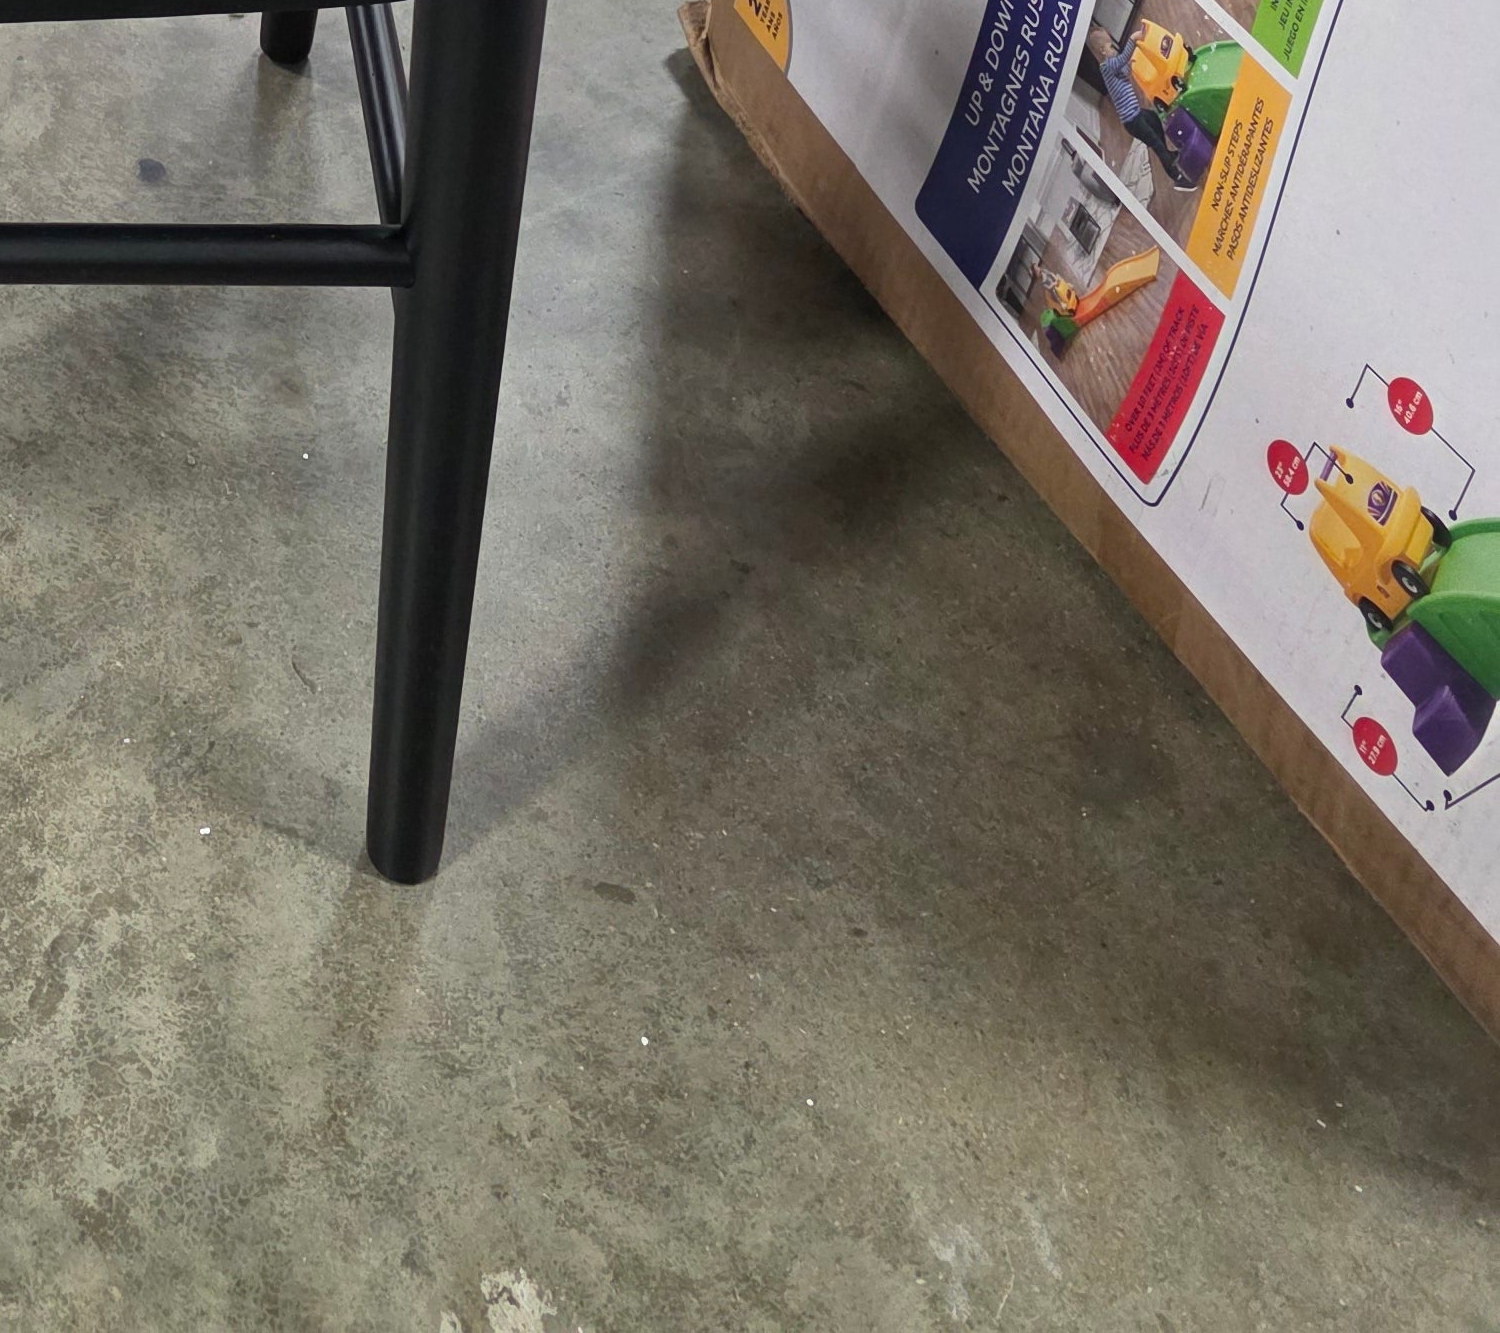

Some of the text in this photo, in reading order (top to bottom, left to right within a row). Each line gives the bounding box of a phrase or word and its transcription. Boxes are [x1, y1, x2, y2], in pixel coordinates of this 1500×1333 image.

[766, 11, 776, 33] ANS
[1278, 8, 1290, 30] JEU
[1284, 22, 1299, 61] JUEGO
[1295, 6, 1305, 23] EN
[964, 90, 984, 127] UP
[978, 72, 994, 92] &
[967, 44, 1030, 194] MONTAGNES
[1002, 75, 1055, 196] MONTAÑA
[1043, 0, 1073, 73] RUSA
[1211, 119, 1243, 212] NON-SLIP STEPS
[1212, 96, 1265, 257] MARCHES ANTIDÉRAPANTES
[1226, 116, 1274, 261] PASOS ANTIDESLIZANTES
[1125, 408, 1141, 433] OVER
[1168, 306, 1185, 343] TRACK
[1163, 384, 1184, 423] METROS
[1413, 391, 1423, 405] cm
[1291, 456, 1301, 471] cm
[1377, 734, 1387, 749] cm
